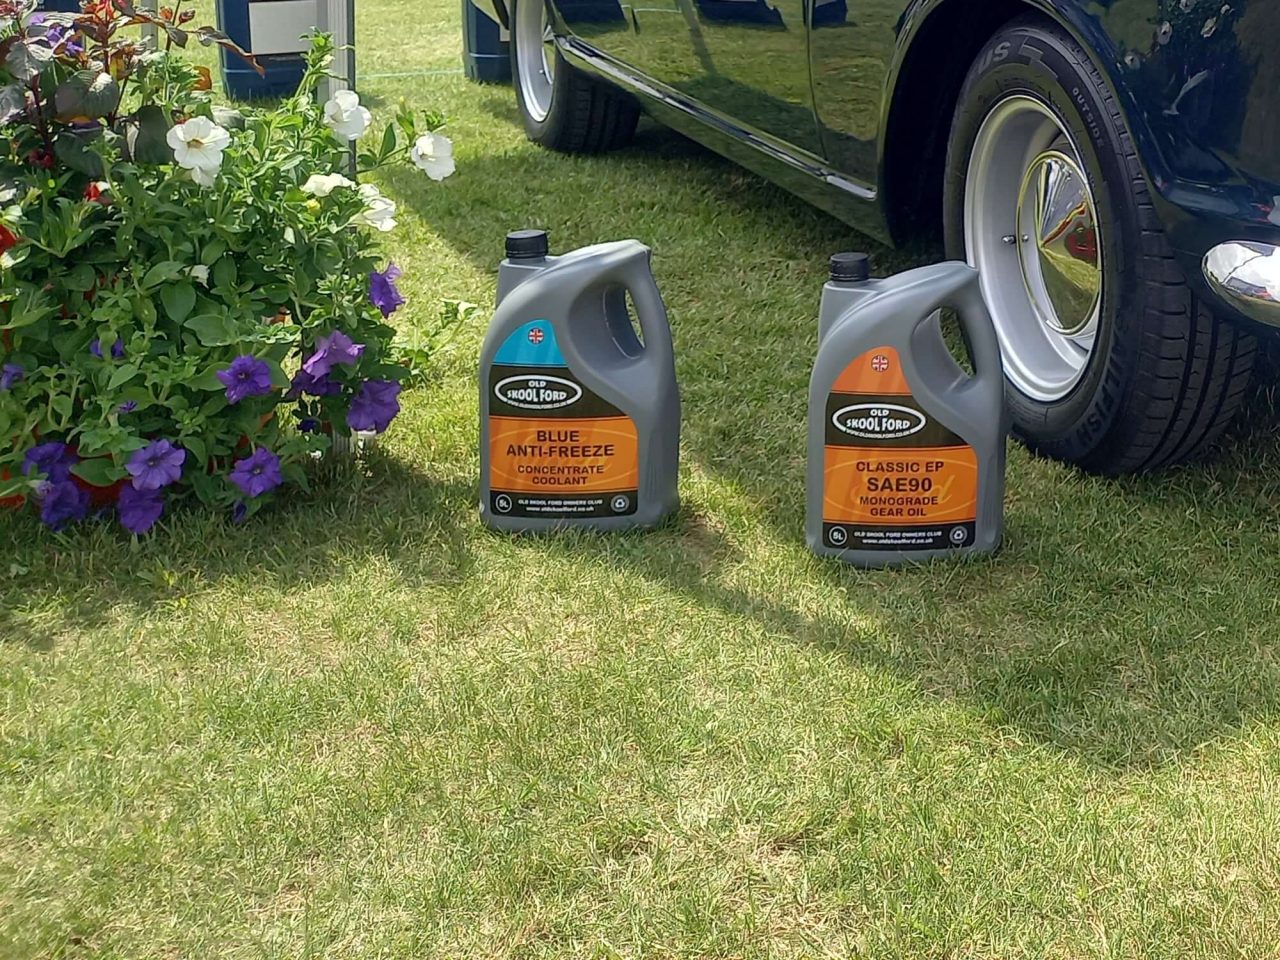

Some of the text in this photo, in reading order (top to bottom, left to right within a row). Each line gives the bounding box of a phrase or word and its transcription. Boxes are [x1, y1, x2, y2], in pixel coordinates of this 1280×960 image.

[528, 380, 547, 388] OLD
[506, 388, 568, 402] SKOOL FORD
[870, 409, 889, 417] OLD
[846, 416, 910, 431] SKOOL FORD
[536, 430, 580, 443] BLUE
[506, 444, 615, 458] ANTI-FREEZE
[517, 464, 605, 474] CONCENTRATE
[855, 461, 945, 473] CLASSIC EP
[532, 476, 588, 486] COOLANT
[867, 477, 933, 493] SAE90
[499, 499, 509, 508] 5L
[859, 496, 939, 506] MONOGRADE
[870, 507, 927, 517] GEAR OIL
[832, 531, 844, 541] 5L
